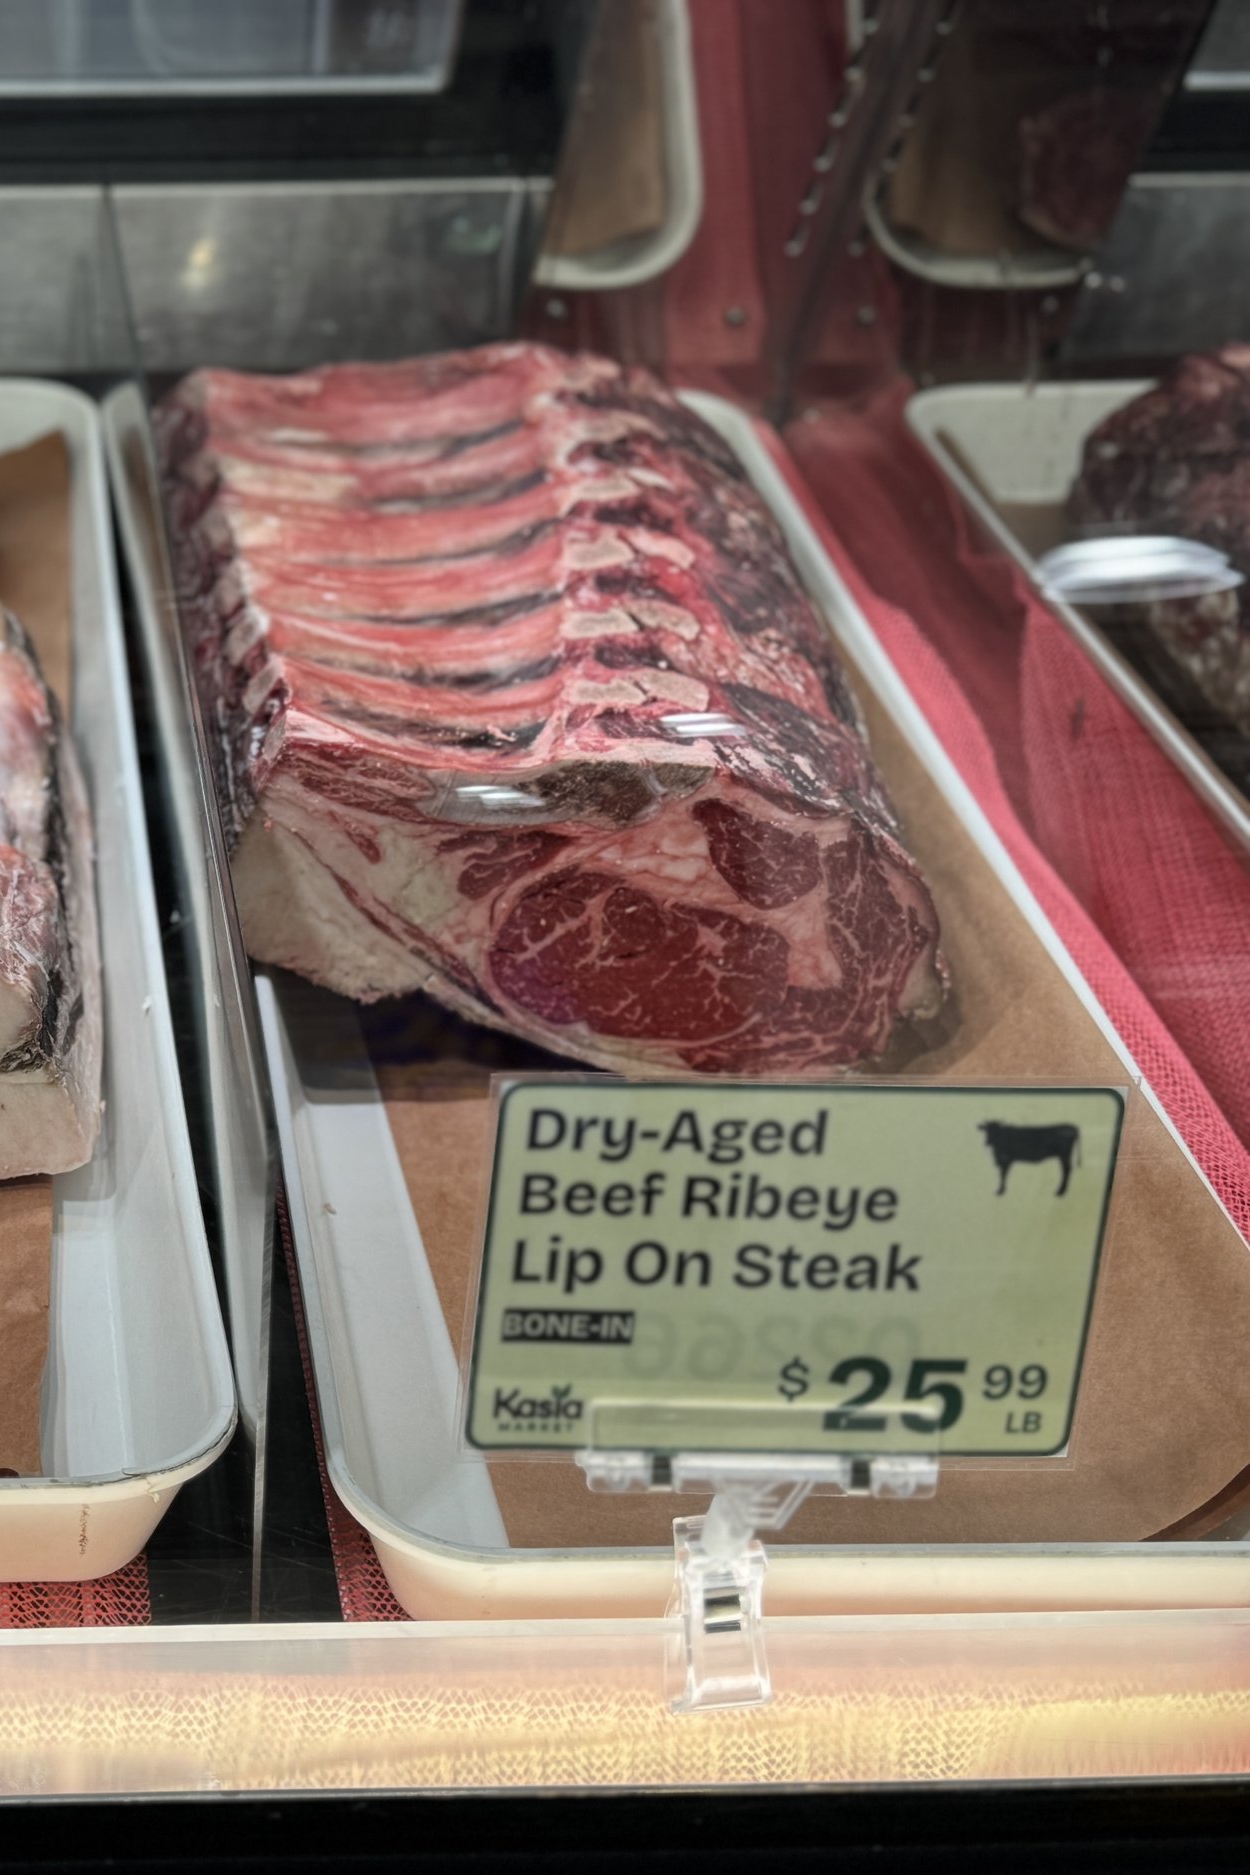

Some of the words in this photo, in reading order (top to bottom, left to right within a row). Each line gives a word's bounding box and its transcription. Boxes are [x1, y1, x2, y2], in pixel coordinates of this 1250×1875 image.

[525, 1108, 829, 1165] Dry-Aged
[519, 1173, 666, 1217] Beef
[681, 1174, 900, 1231] Ribeye
[510, 1236, 604, 1294] Lip
[624, 1240, 712, 1287] On
[732, 1242, 922, 1292] Steak
[503, 1312, 633, 1339] BONE-IN
[778, 1356, 810, 1402] $
[822, 1356, 968, 1434] 25
[982, 1365, 1048, 1400] 99
[1005, 1411, 1042, 1434] LB
